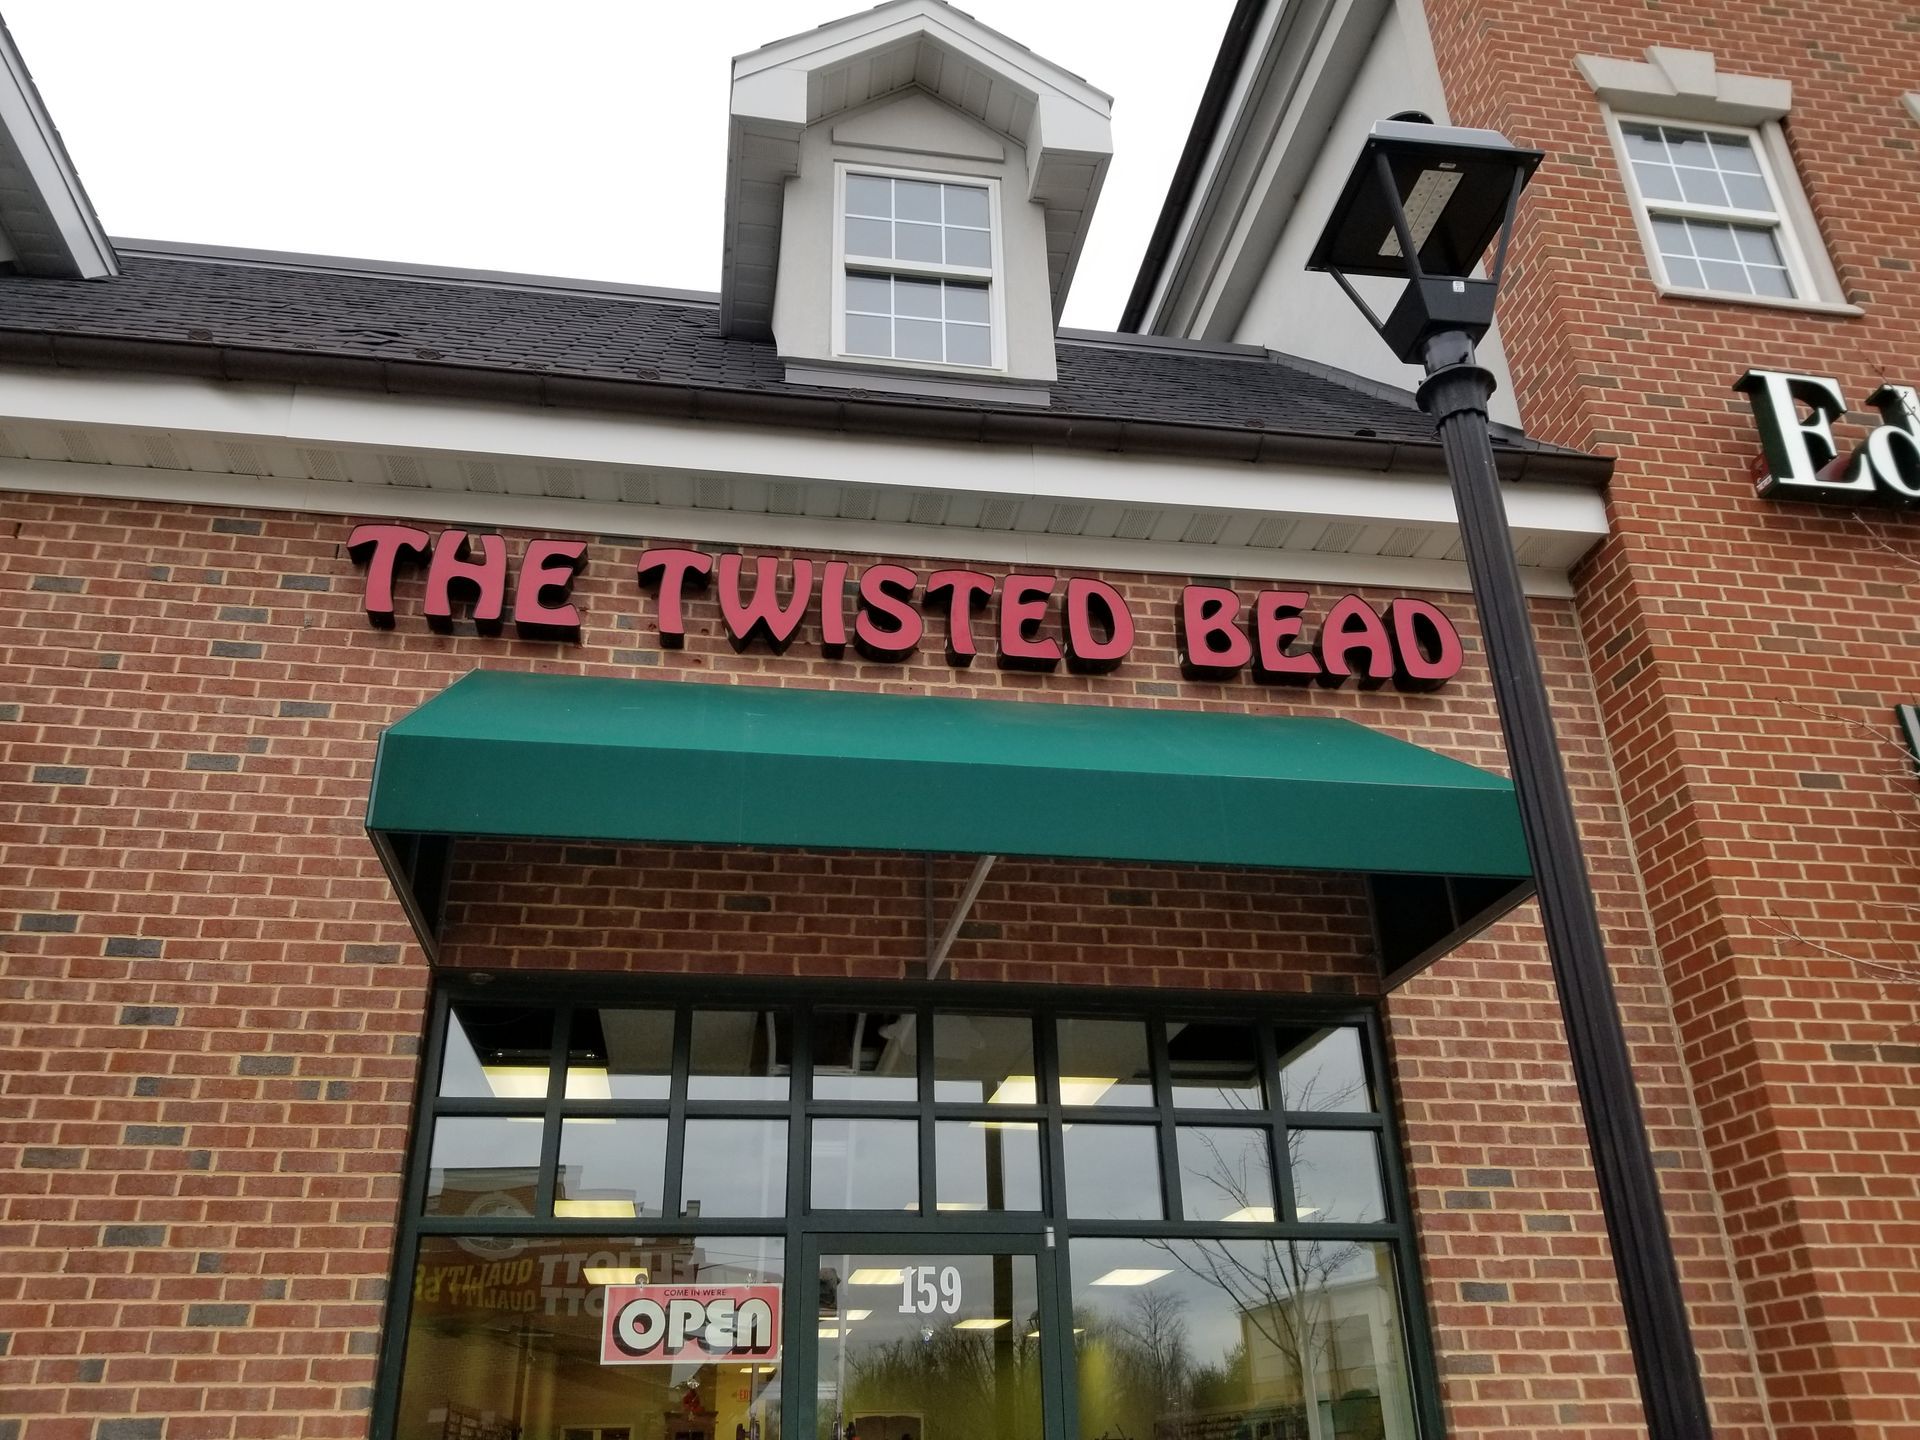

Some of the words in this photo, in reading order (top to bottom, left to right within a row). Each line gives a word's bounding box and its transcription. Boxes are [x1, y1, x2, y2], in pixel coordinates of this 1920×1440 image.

[346, 524, 589, 639] THE
[637, 547, 1135, 675] TWISTED
[1179, 585, 1464, 689] BEAD
[664, 1289, 688, 1297] COME
[899, 1266, 962, 1314] 159
[613, 1298, 773, 1355] OPEN
